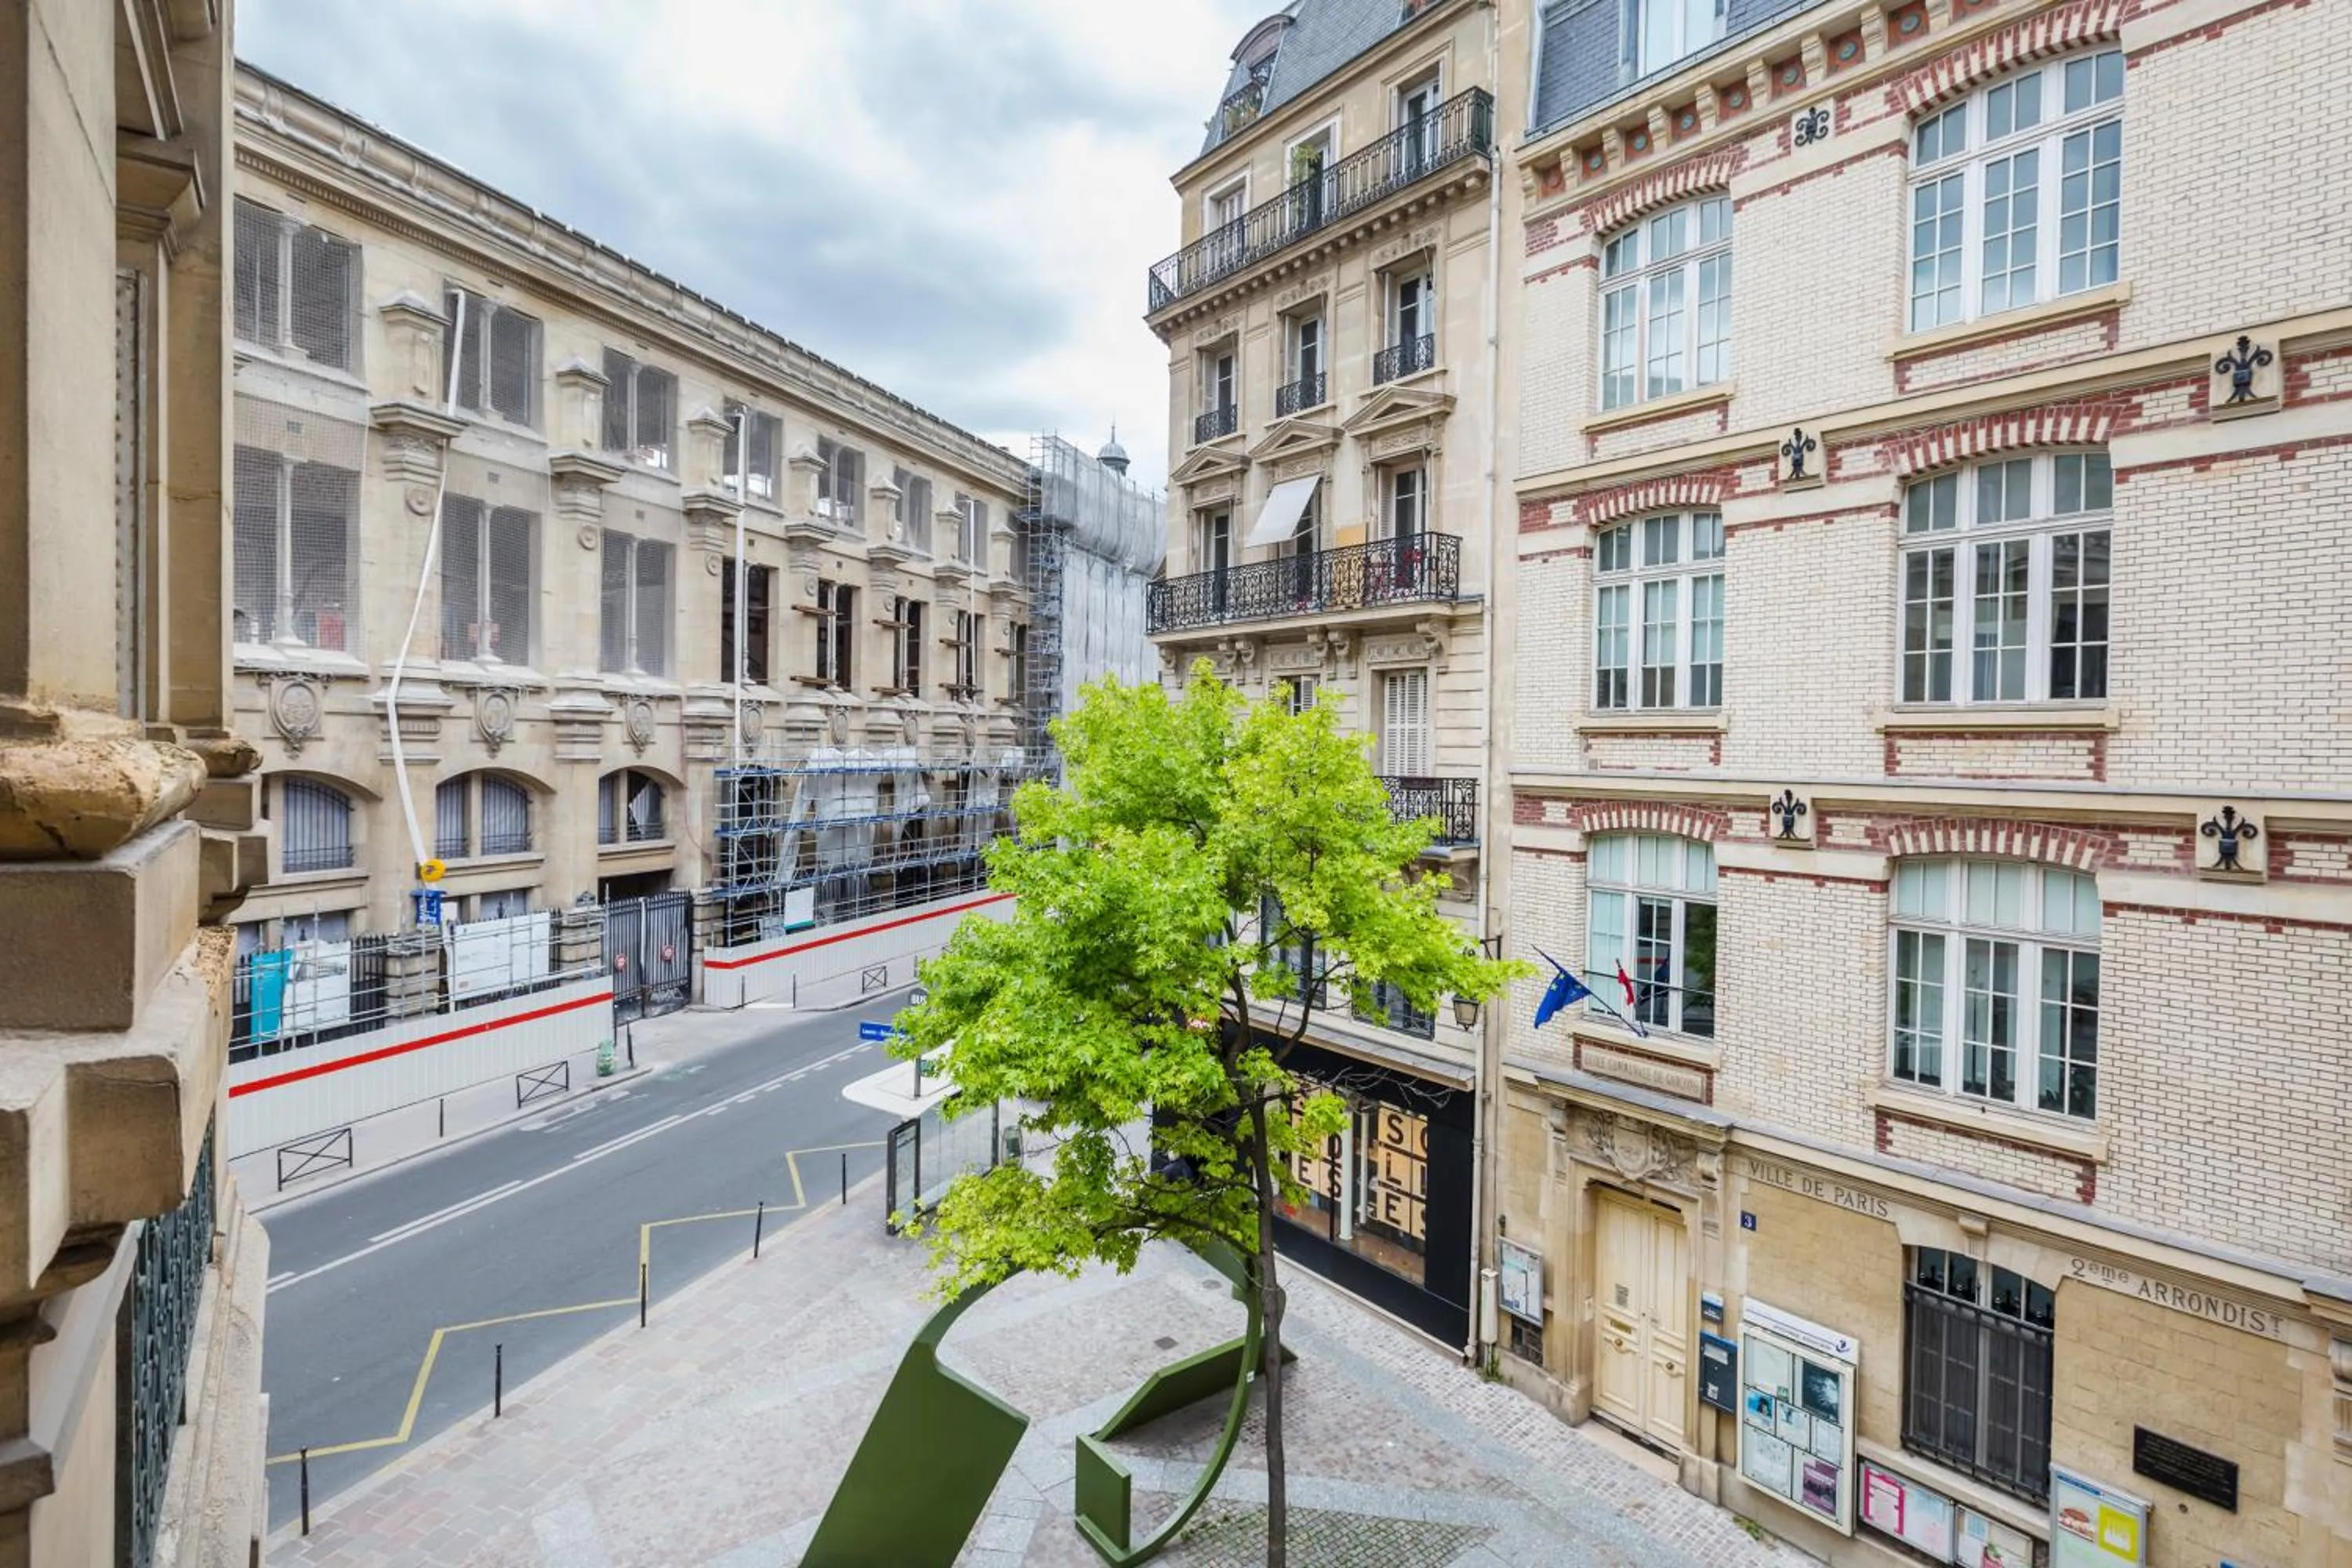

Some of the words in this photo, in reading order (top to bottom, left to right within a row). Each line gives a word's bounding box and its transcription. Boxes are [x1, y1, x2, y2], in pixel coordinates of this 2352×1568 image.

[1749, 1160, 1793, 1188] VILLE
[1802, 1177, 1824, 1197] DE
[1835, 1186, 1889, 1218] PARIS
[1744, 1215, 1752, 1229] 3
